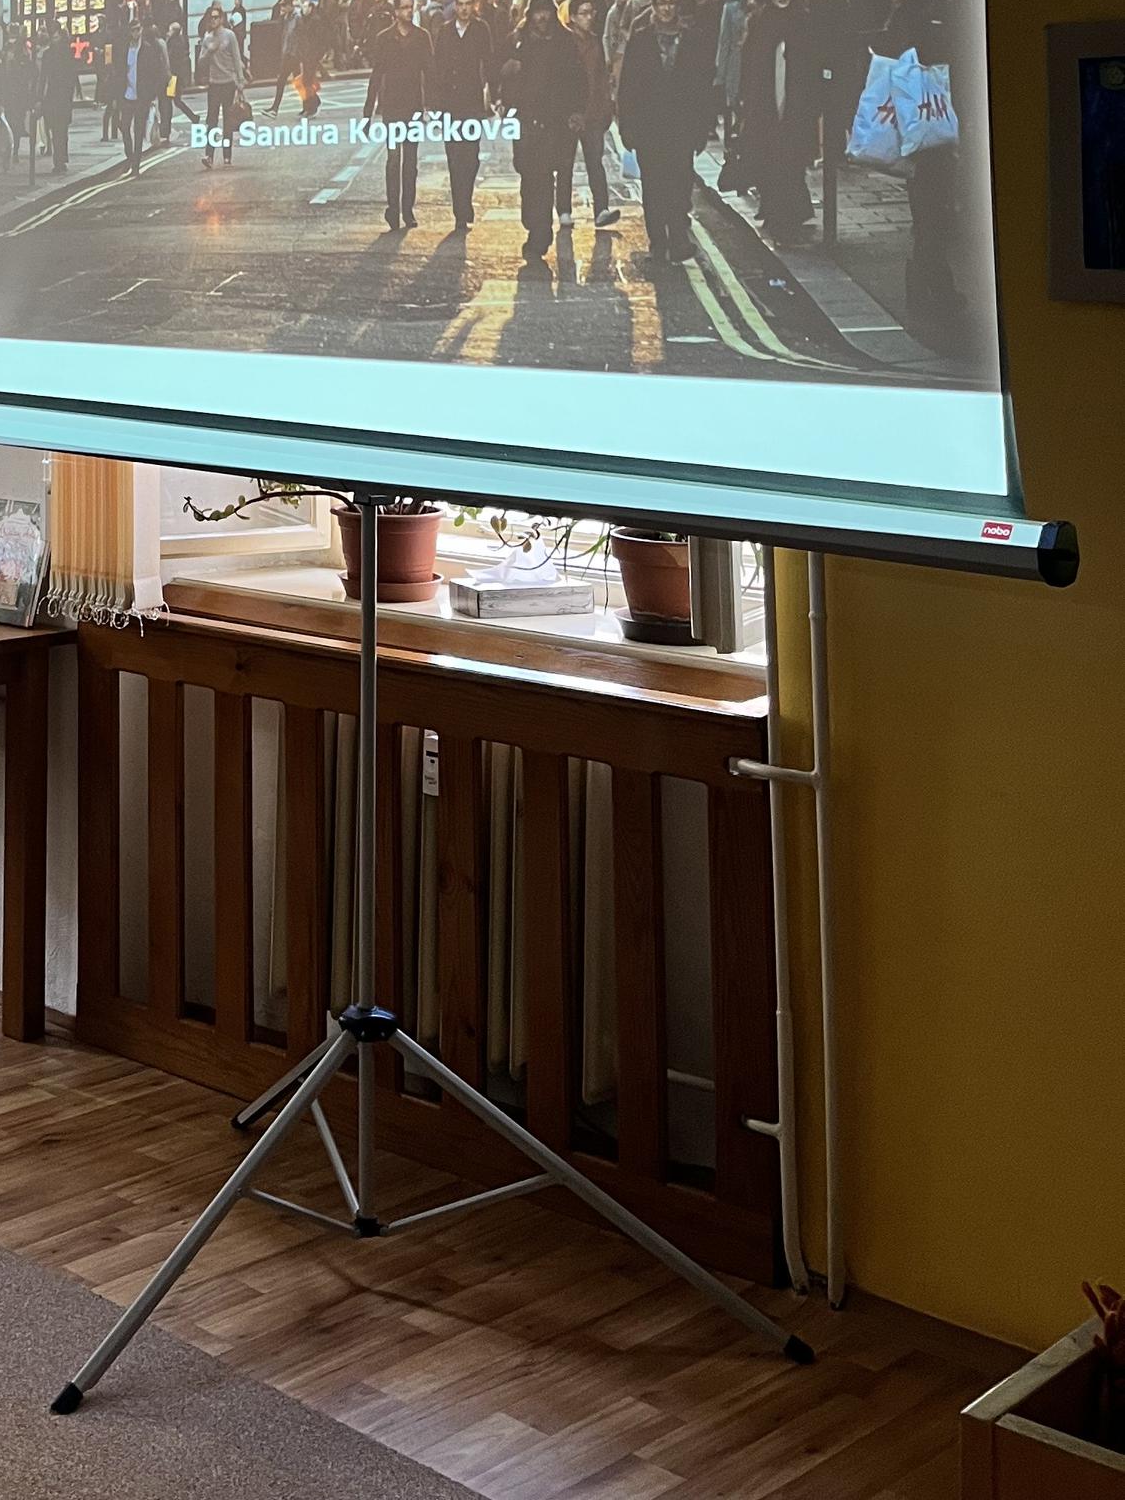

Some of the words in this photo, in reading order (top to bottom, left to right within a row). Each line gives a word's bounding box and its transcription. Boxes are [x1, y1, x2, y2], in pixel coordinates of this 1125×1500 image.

[190, 123, 230, 148] Bc.
[239, 117, 339, 147] Sandra
[349, 107, 521, 150] Kopáčková
[983, 525, 1011, 537] nobo
